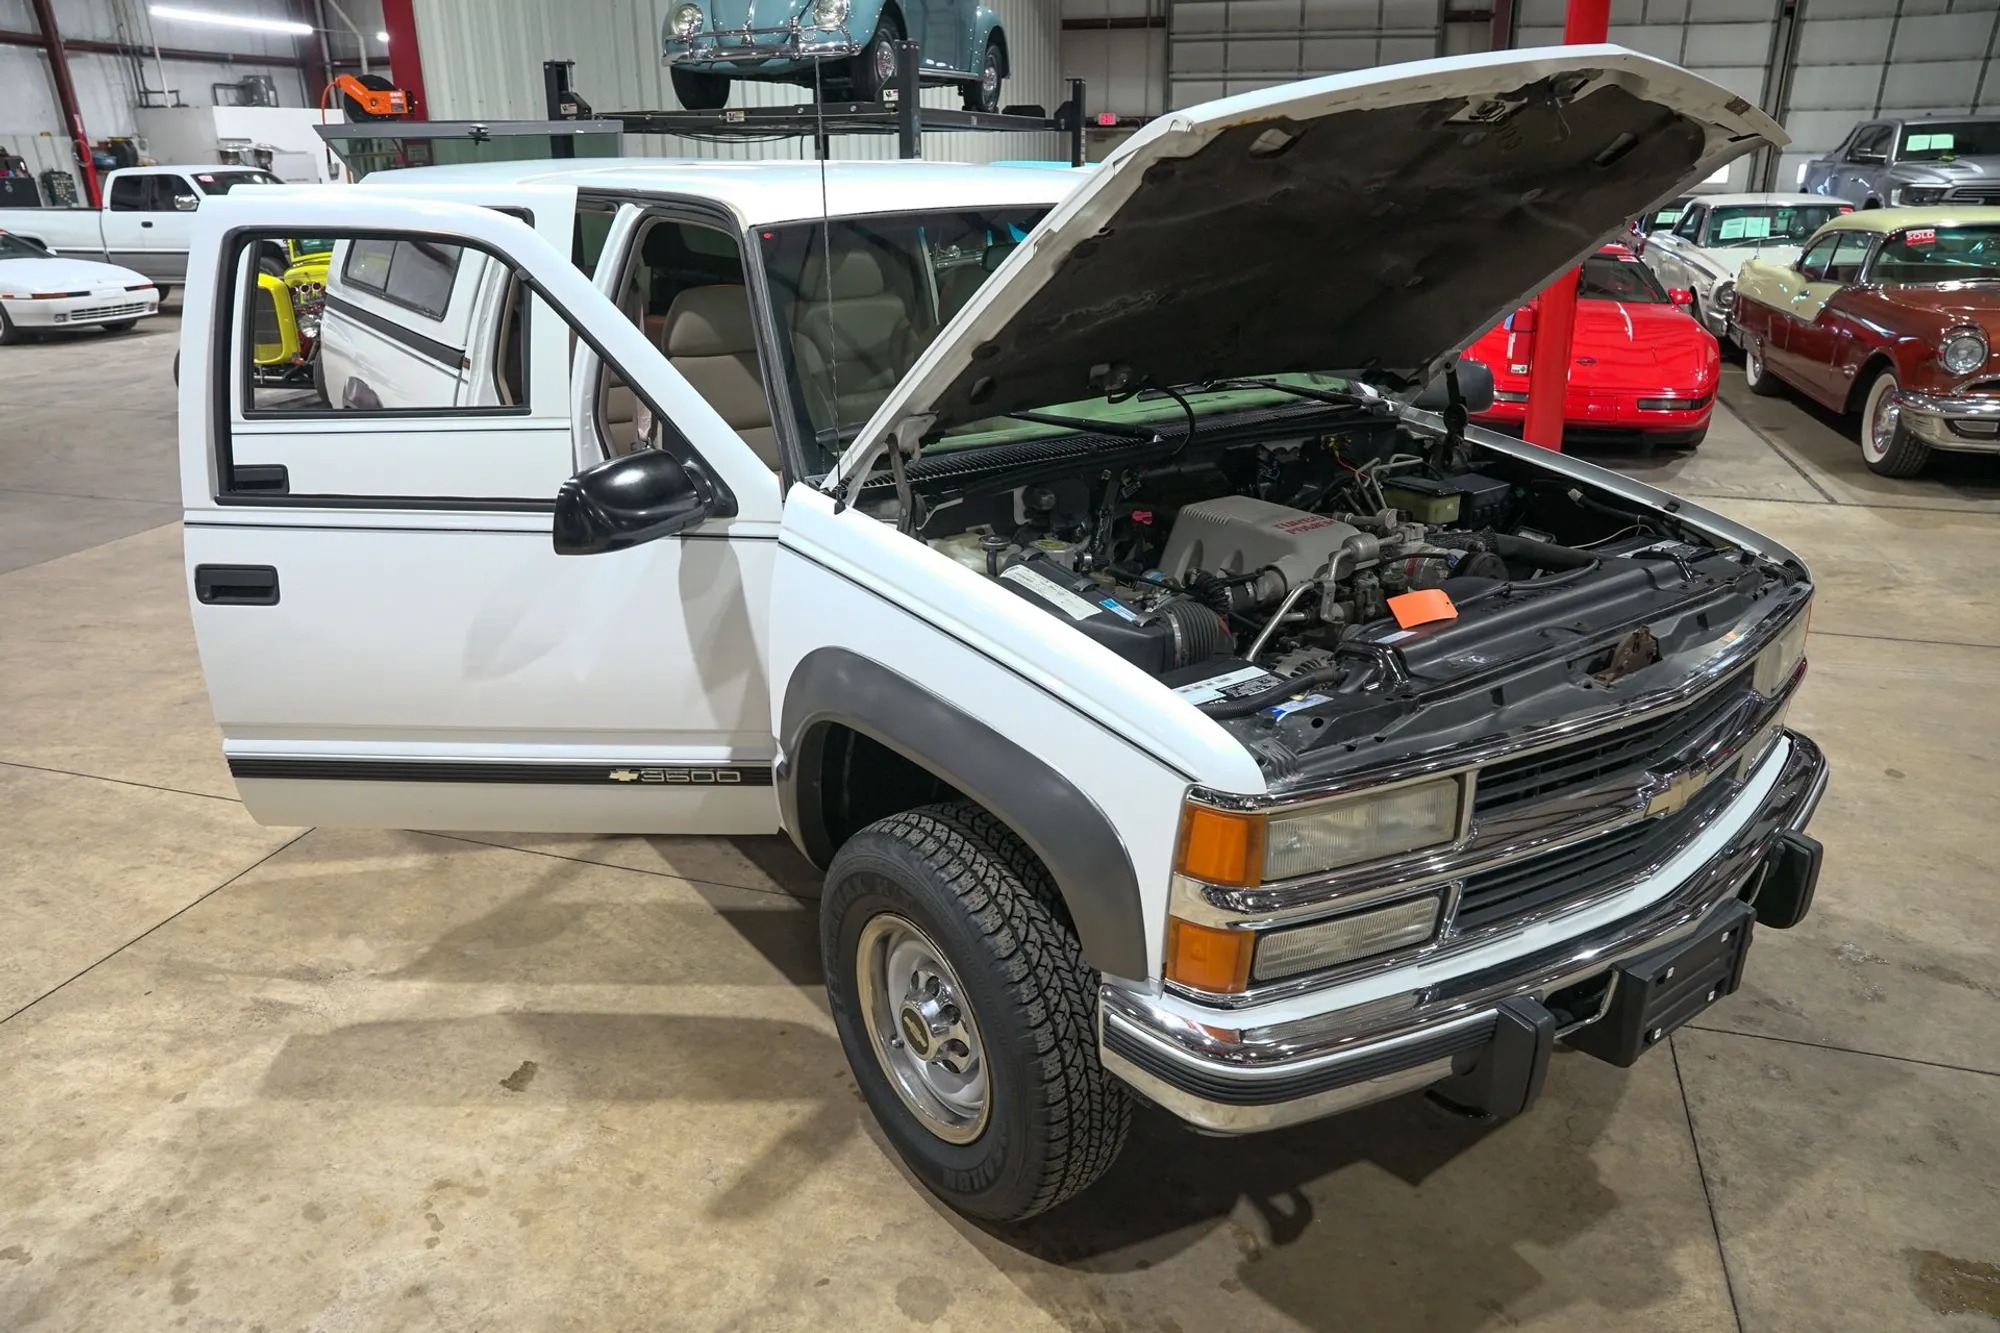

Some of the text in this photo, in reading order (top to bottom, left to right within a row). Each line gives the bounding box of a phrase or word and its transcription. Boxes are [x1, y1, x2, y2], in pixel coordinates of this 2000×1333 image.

[1906, 231, 1935, 241] SOLD
[1272, 515, 1325, 529] TURBO
[1285, 519, 1335, 534] POWER
[640, 768, 742, 783] 3500
